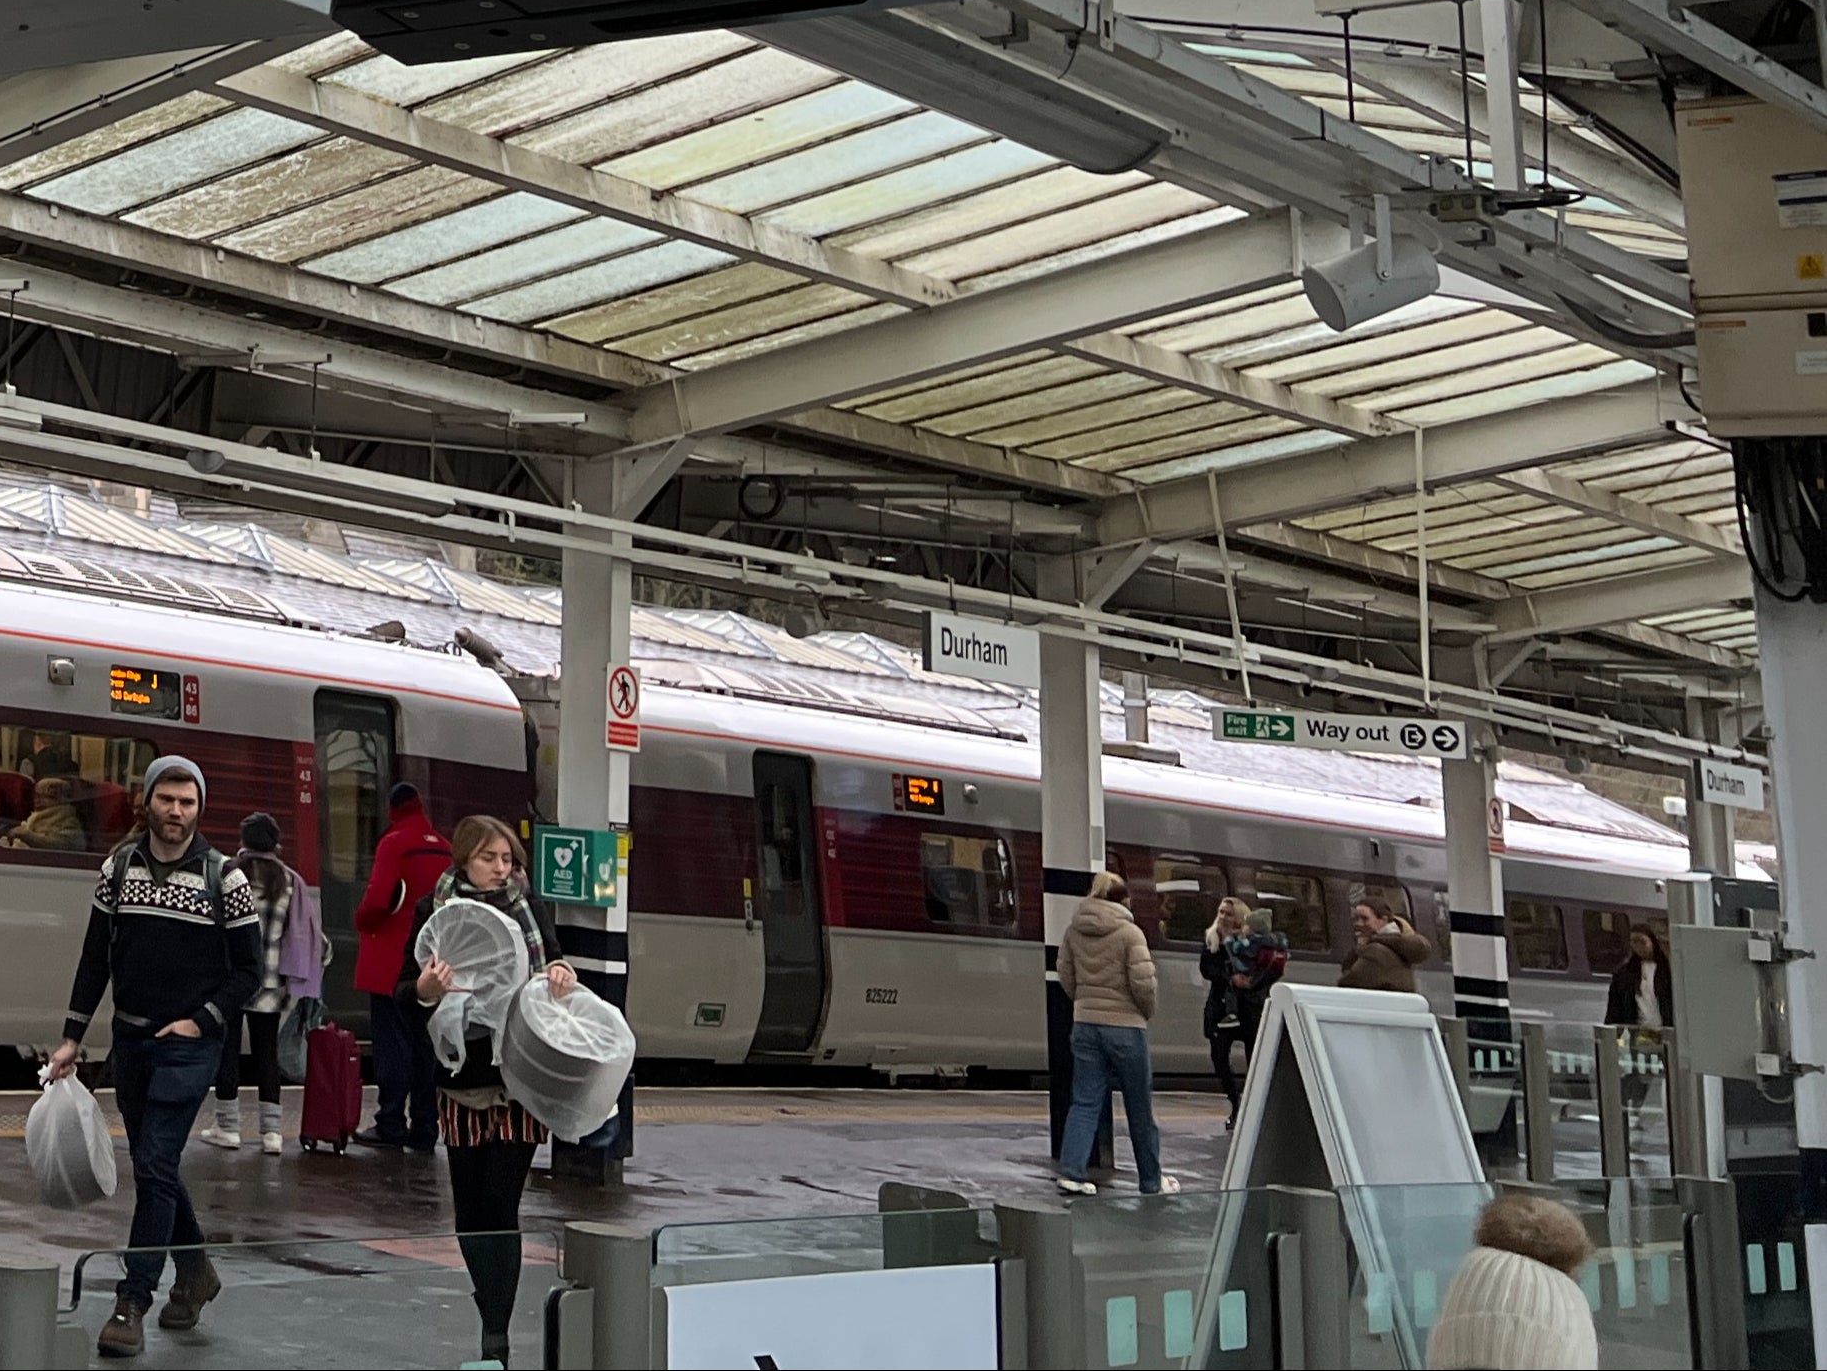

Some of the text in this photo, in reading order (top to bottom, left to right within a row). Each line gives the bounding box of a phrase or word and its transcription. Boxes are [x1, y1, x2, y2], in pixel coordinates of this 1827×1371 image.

[941, 626, 1007, 666] Durham
[185, 683, 197, 694] 43
[1226, 715, 1247, 726] Fire
[1228, 725, 1247, 736] exit
[1306, 720, 1389, 742] Way out
[1707, 769, 1746, 796] Durham
[554, 869, 573, 879] AED
